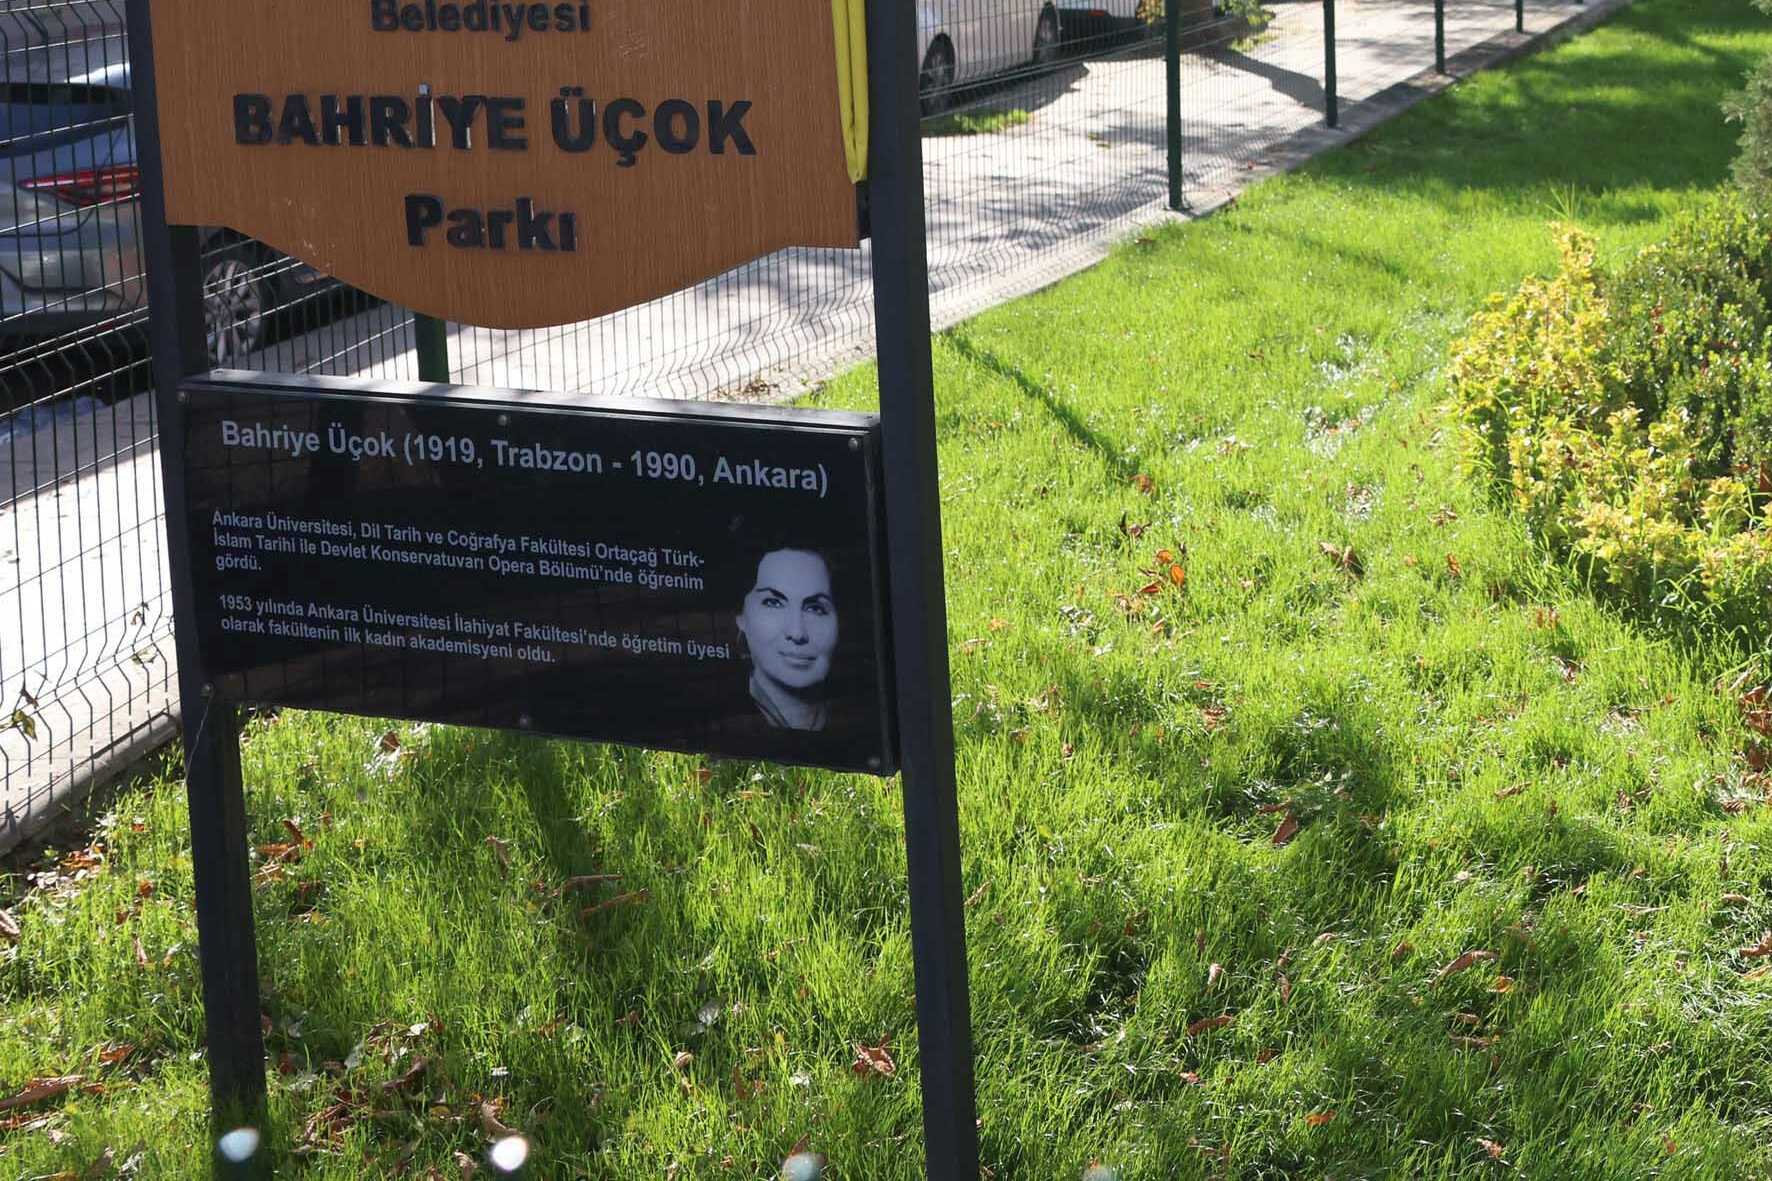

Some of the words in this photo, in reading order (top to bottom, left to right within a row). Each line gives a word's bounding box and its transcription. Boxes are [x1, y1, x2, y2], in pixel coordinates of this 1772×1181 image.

[233, 83, 528, 151] BAHRİYE
[550, 86, 757, 168] ÜÇOK
[403, 193, 577, 253] Parkı
[222, 420, 320, 457] Bahriye
[328, 423, 396, 461] Üçok
[404, 433, 483, 469] (1919,
[491, 439, 602, 473] Trabzon
[630, 450, 704, 486] 1990,
[713, 457, 828, 498] Ankara)
[212, 510, 263, 529] Ankara
[266, 511, 357, 539] Üniversitesi,
[360, 522, 382, 539] Dil
[384, 524, 421, 543] Tarih
[426, 531, 443, 545] ve
[447, 530, 516, 554] Coğrafya
[521, 536, 591, 558] Fakültesi
[595, 543, 657, 567] Ortaçağ
[662, 549, 705, 567] Türk-
[215, 554, 262, 571] gördü.
[256, 534, 296, 553] Tarihi
[300, 538, 317, 554] ile
[321, 540, 367, 559] Devlet
[371, 545, 484, 570] Konservatuvarı
[489, 555, 535, 575] Opera
[540, 561, 633, 584] Bölümü'nde
[638, 568, 704, 590] öğrenim
[219, 594, 252, 612] 1953
[256, 598, 304, 617] yılında
[307, 603, 359, 622] Ankara
[363, 604, 450, 631] Üniversitesi
[455, 613, 510, 639] İlahiyat
[514, 622, 617, 648] Fakültesi'nde
[622, 633, 682, 655] öğretim
[687, 640, 730, 660] üyesi
[221, 615, 265, 634] olarak
[268, 619, 340, 641] fakültenin
[343, 626, 361, 644] ilk
[365, 629, 406, 648] kadın
[410, 634, 512, 660] akademisyeni
[517, 645, 556, 664] oldu.
